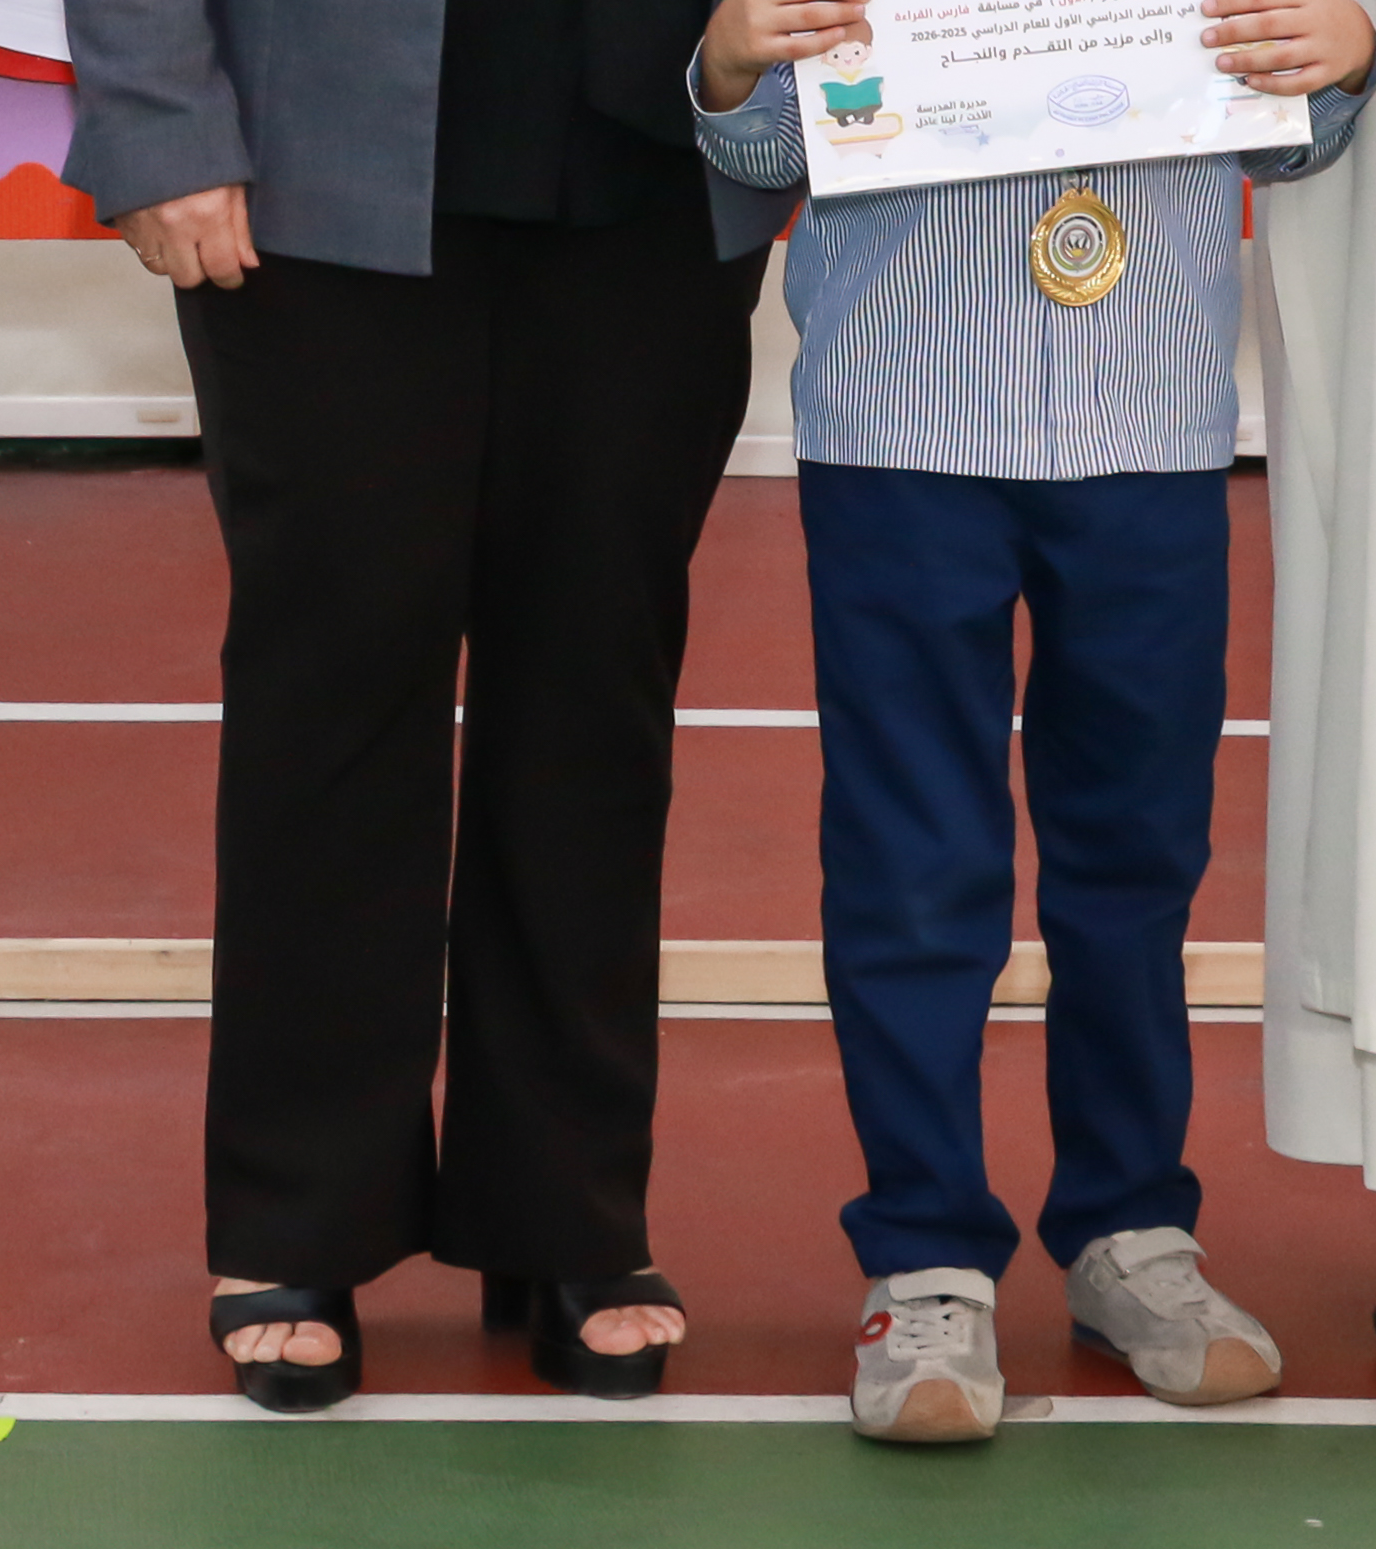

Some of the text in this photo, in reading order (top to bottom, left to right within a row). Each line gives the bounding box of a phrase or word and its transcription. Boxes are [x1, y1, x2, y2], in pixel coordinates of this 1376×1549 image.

[937, 4, 970, 18] فارس
[977, 0, 1020, 14] مسابقة
[1137, 5, 1172, 20] الفصل
[1176, 3, 1195, 18] في
[894, 8, 933, 22] القراءة
[1054, 14, 1082, 29] الأول
[1086, 9, 1133, 27] الدراسي
[971, 21, 1018, 39] الدراسي
[1023, 17, 1050, 33] للعام
[1103, 34, 1134, 49] مزيد
[1140, 29, 1173, 45] وإلى
[1078, 38, 1098, 52] من
[916, 101, 957, 114] المدرسة
